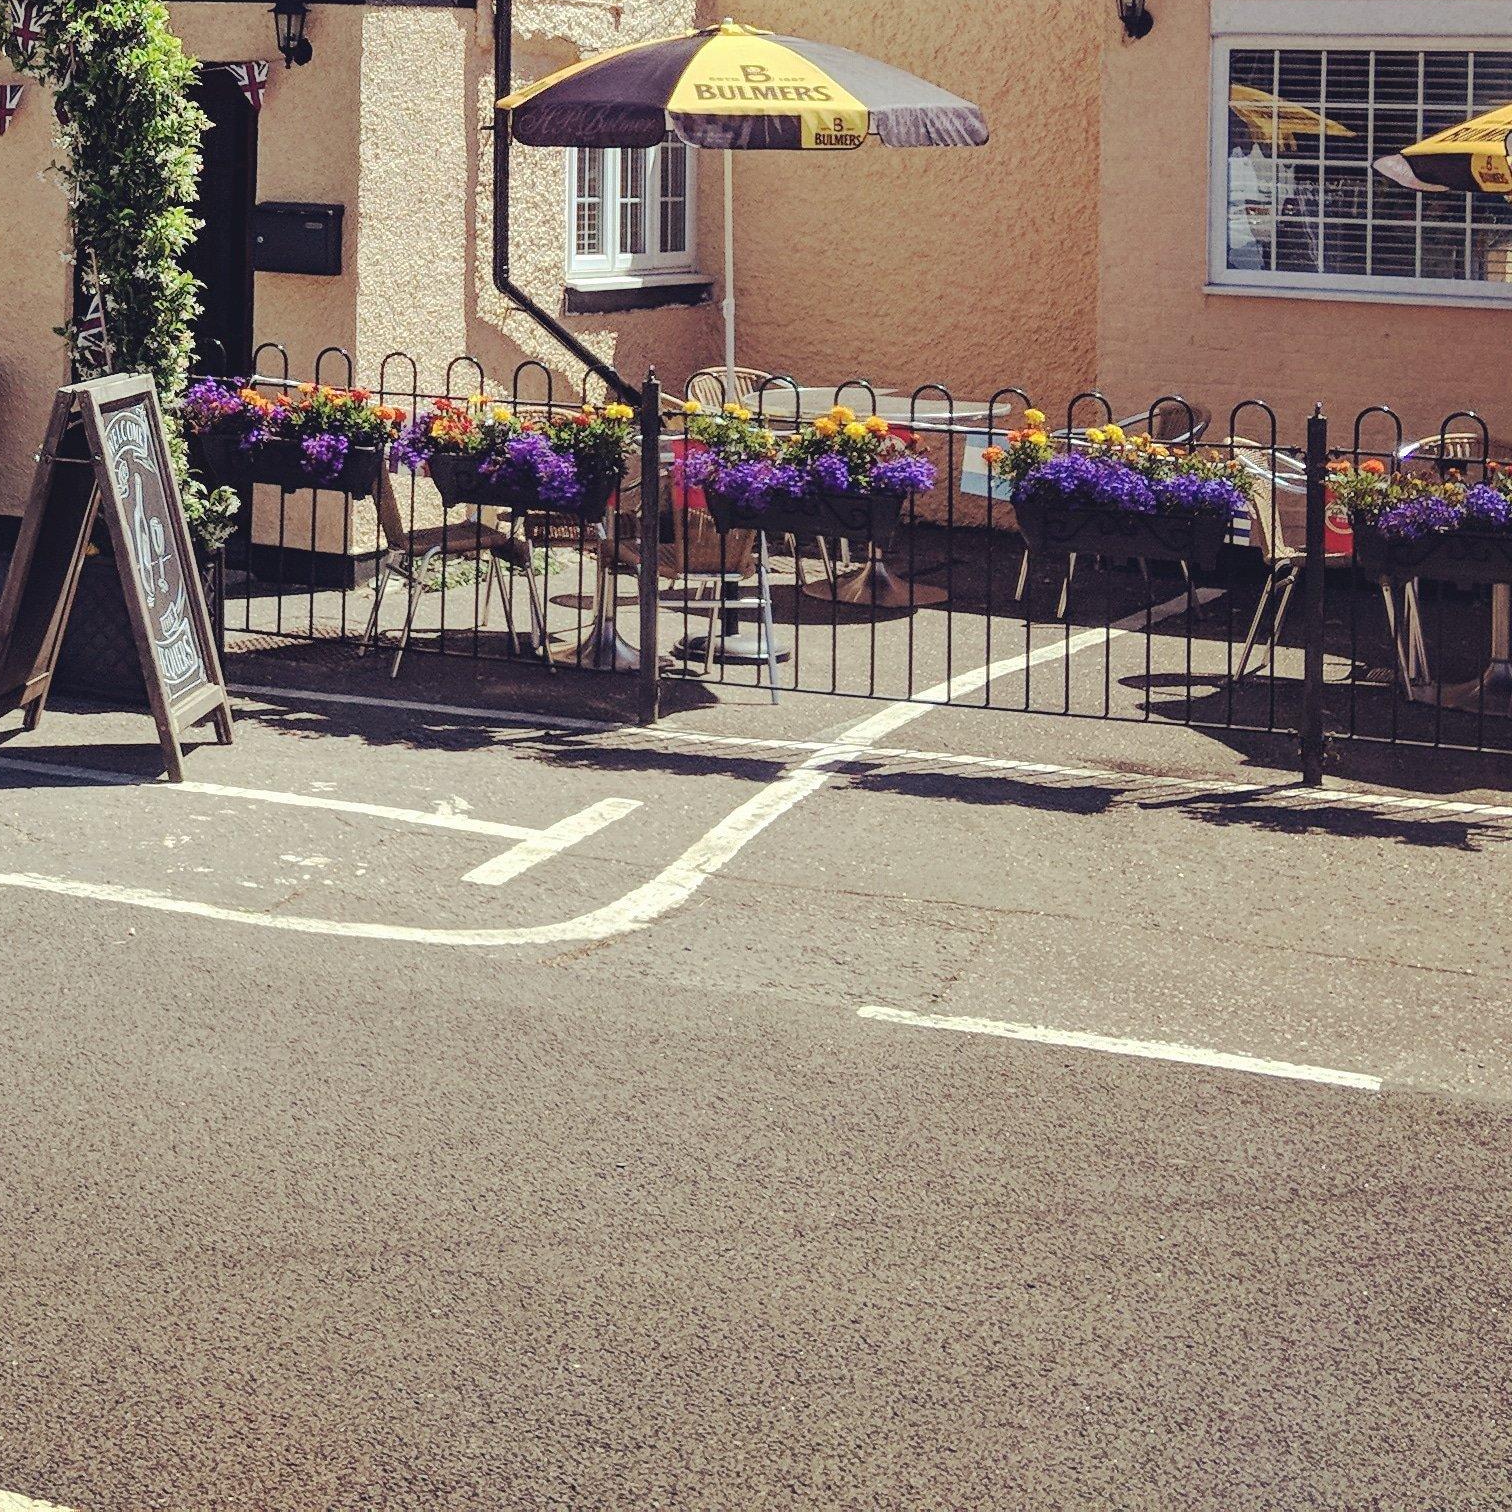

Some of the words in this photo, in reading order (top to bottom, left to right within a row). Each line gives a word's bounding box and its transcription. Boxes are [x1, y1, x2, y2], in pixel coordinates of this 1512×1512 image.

[739, 64, 772, 83] B
[693, 83, 834, 102] BULMERS
[814, 133, 862, 147] BULMERS
